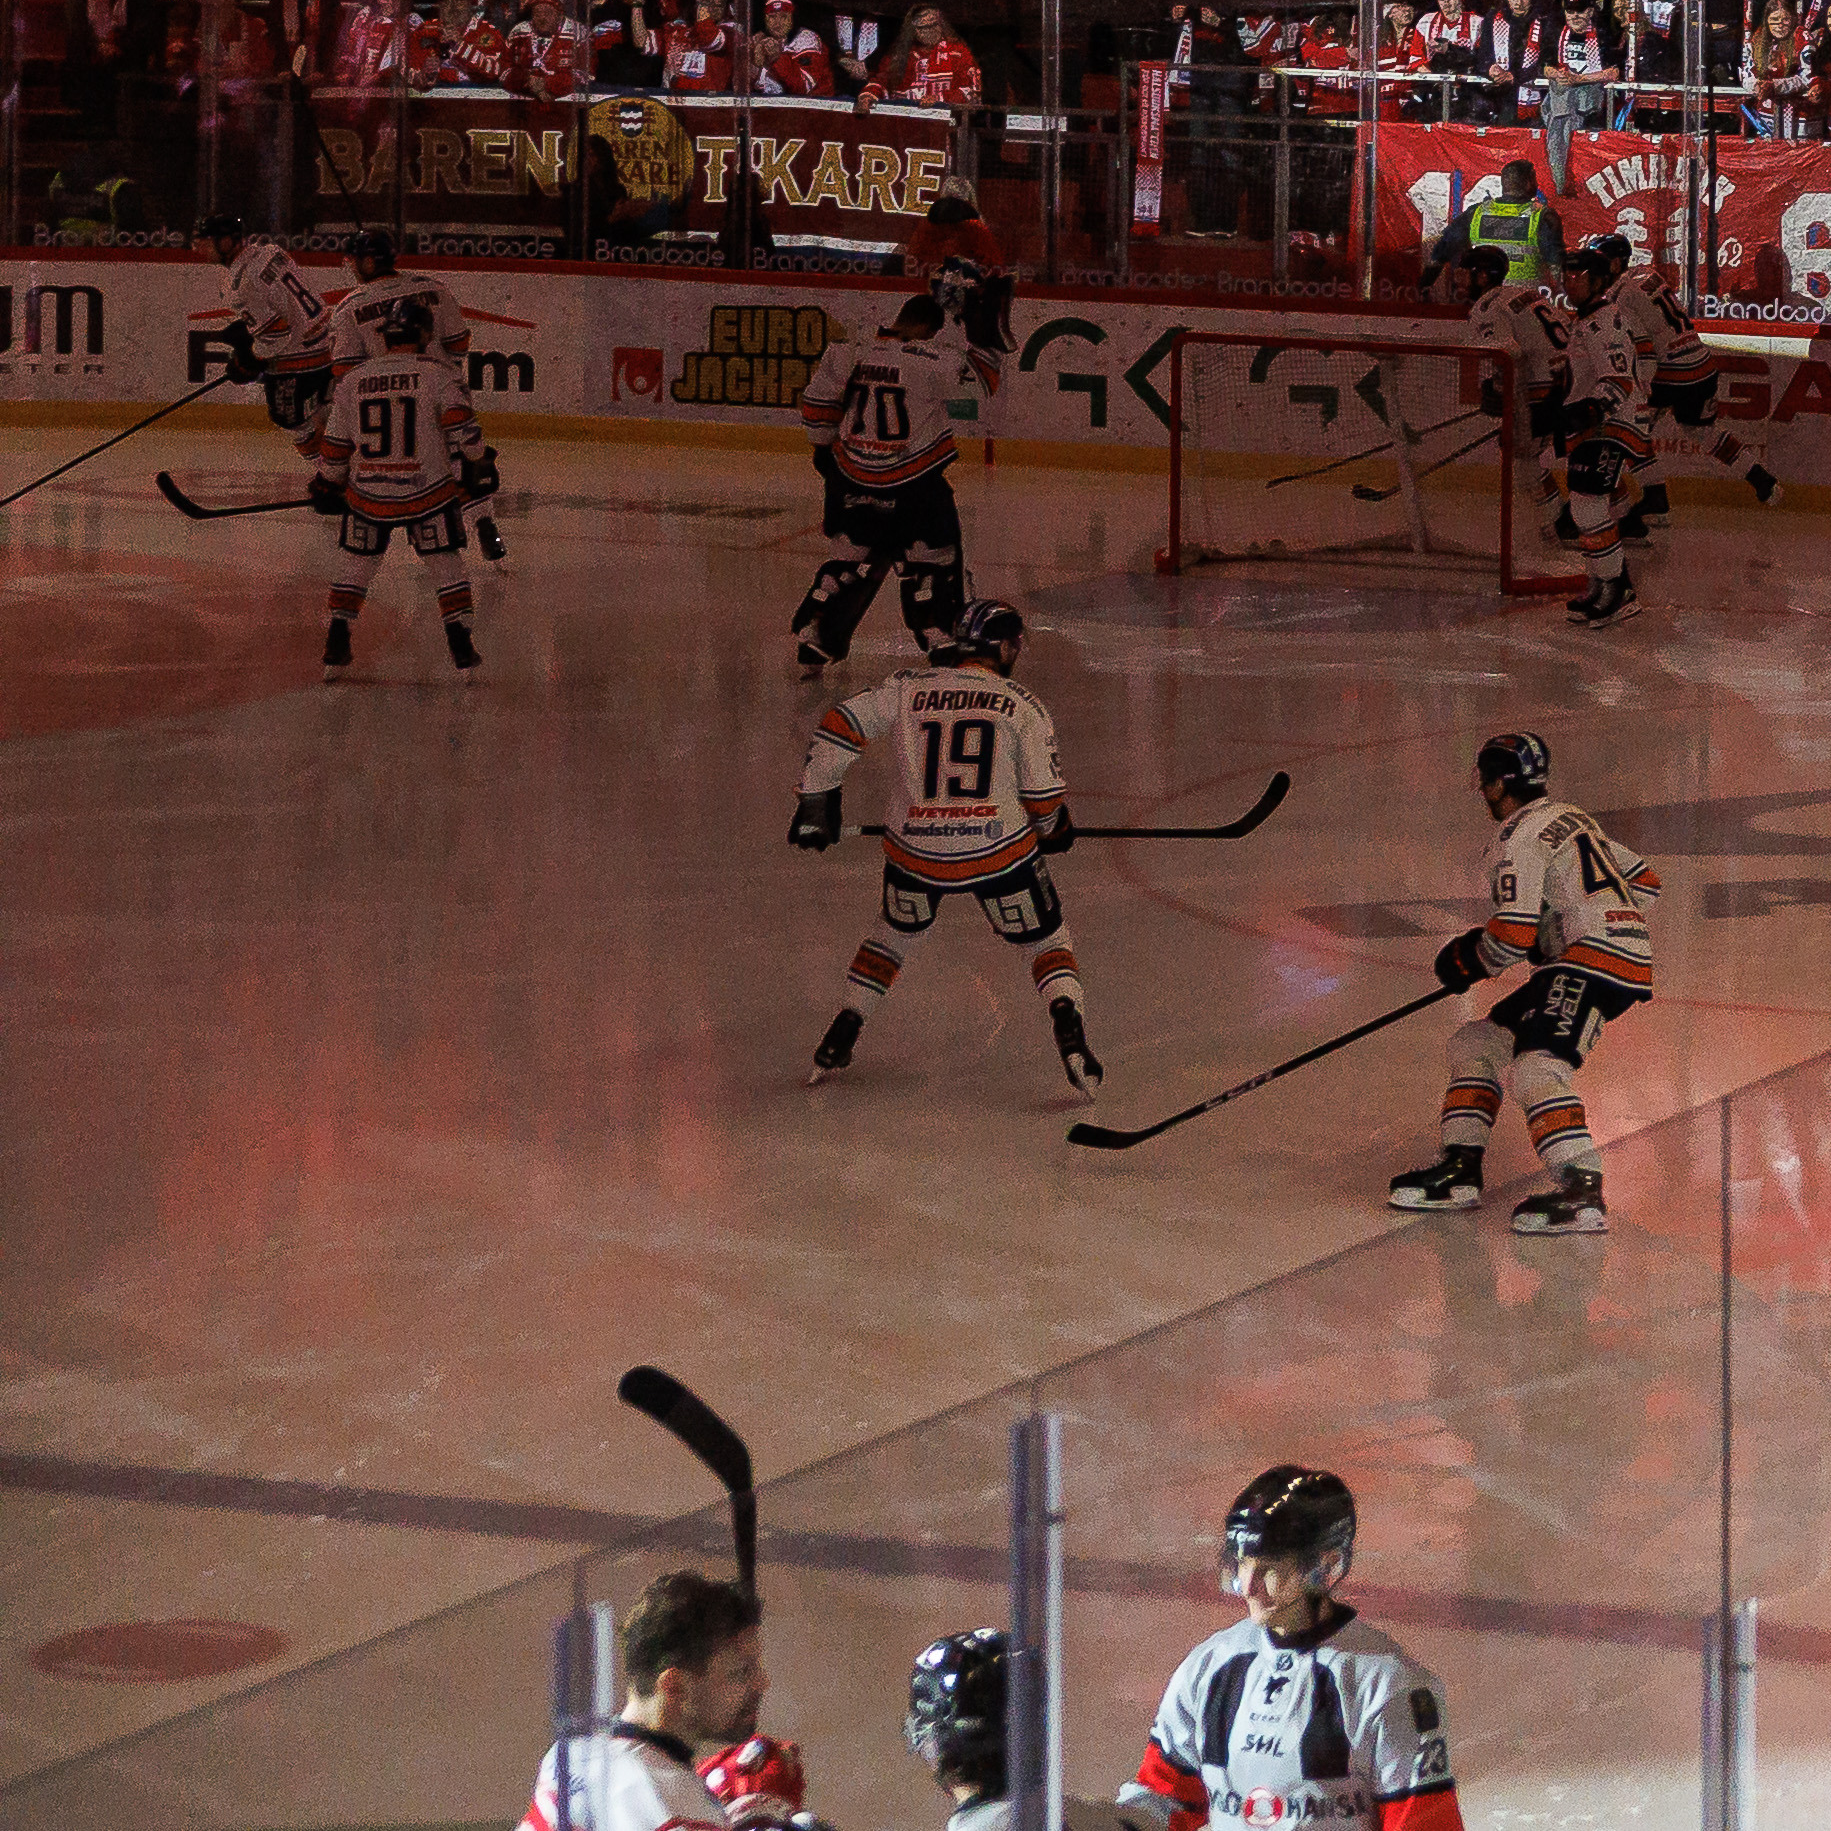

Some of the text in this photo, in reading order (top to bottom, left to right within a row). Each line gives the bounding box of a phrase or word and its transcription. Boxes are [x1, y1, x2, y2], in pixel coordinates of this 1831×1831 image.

[417, 233, 556, 260] Brandcode
[594, 238, 726, 268] Brandcode
[709, 305, 828, 357] EURO
[357, 372, 421, 394] ROBERT
[671, 350, 816, 407] JACKP
[359, 396, 416, 459] 91
[911, 689, 1018, 719] GARDINER
[920, 718, 997, 800] 19
